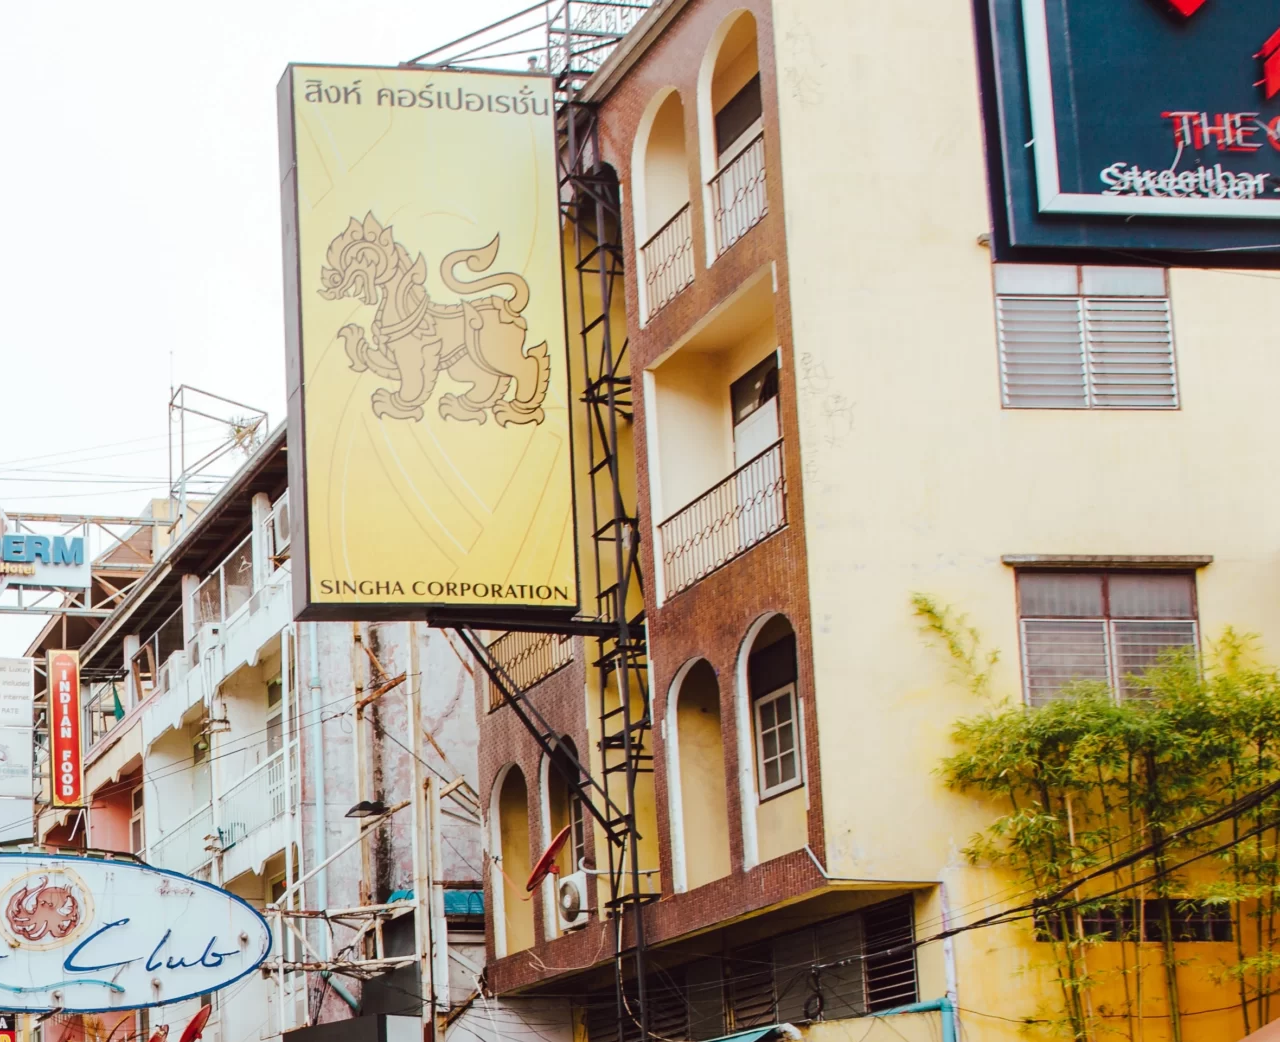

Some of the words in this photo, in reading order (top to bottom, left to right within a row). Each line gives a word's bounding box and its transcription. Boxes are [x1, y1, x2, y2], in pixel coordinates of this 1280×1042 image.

[304, 79, 362, 105] สิงห์
[376, 84, 549, 116] คอร์เปอเรชั่น
[1160, 111, 1264, 152] THE
[0, 562, 36, 576] Hotel
[320, 579, 406, 596] SINGHA
[412, 580, 569, 601] CORPORATION
[59, 669, 73, 739] INDIAN
[62, 749, 74, 797] FOOD
[63, 917, 241, 974] Club
